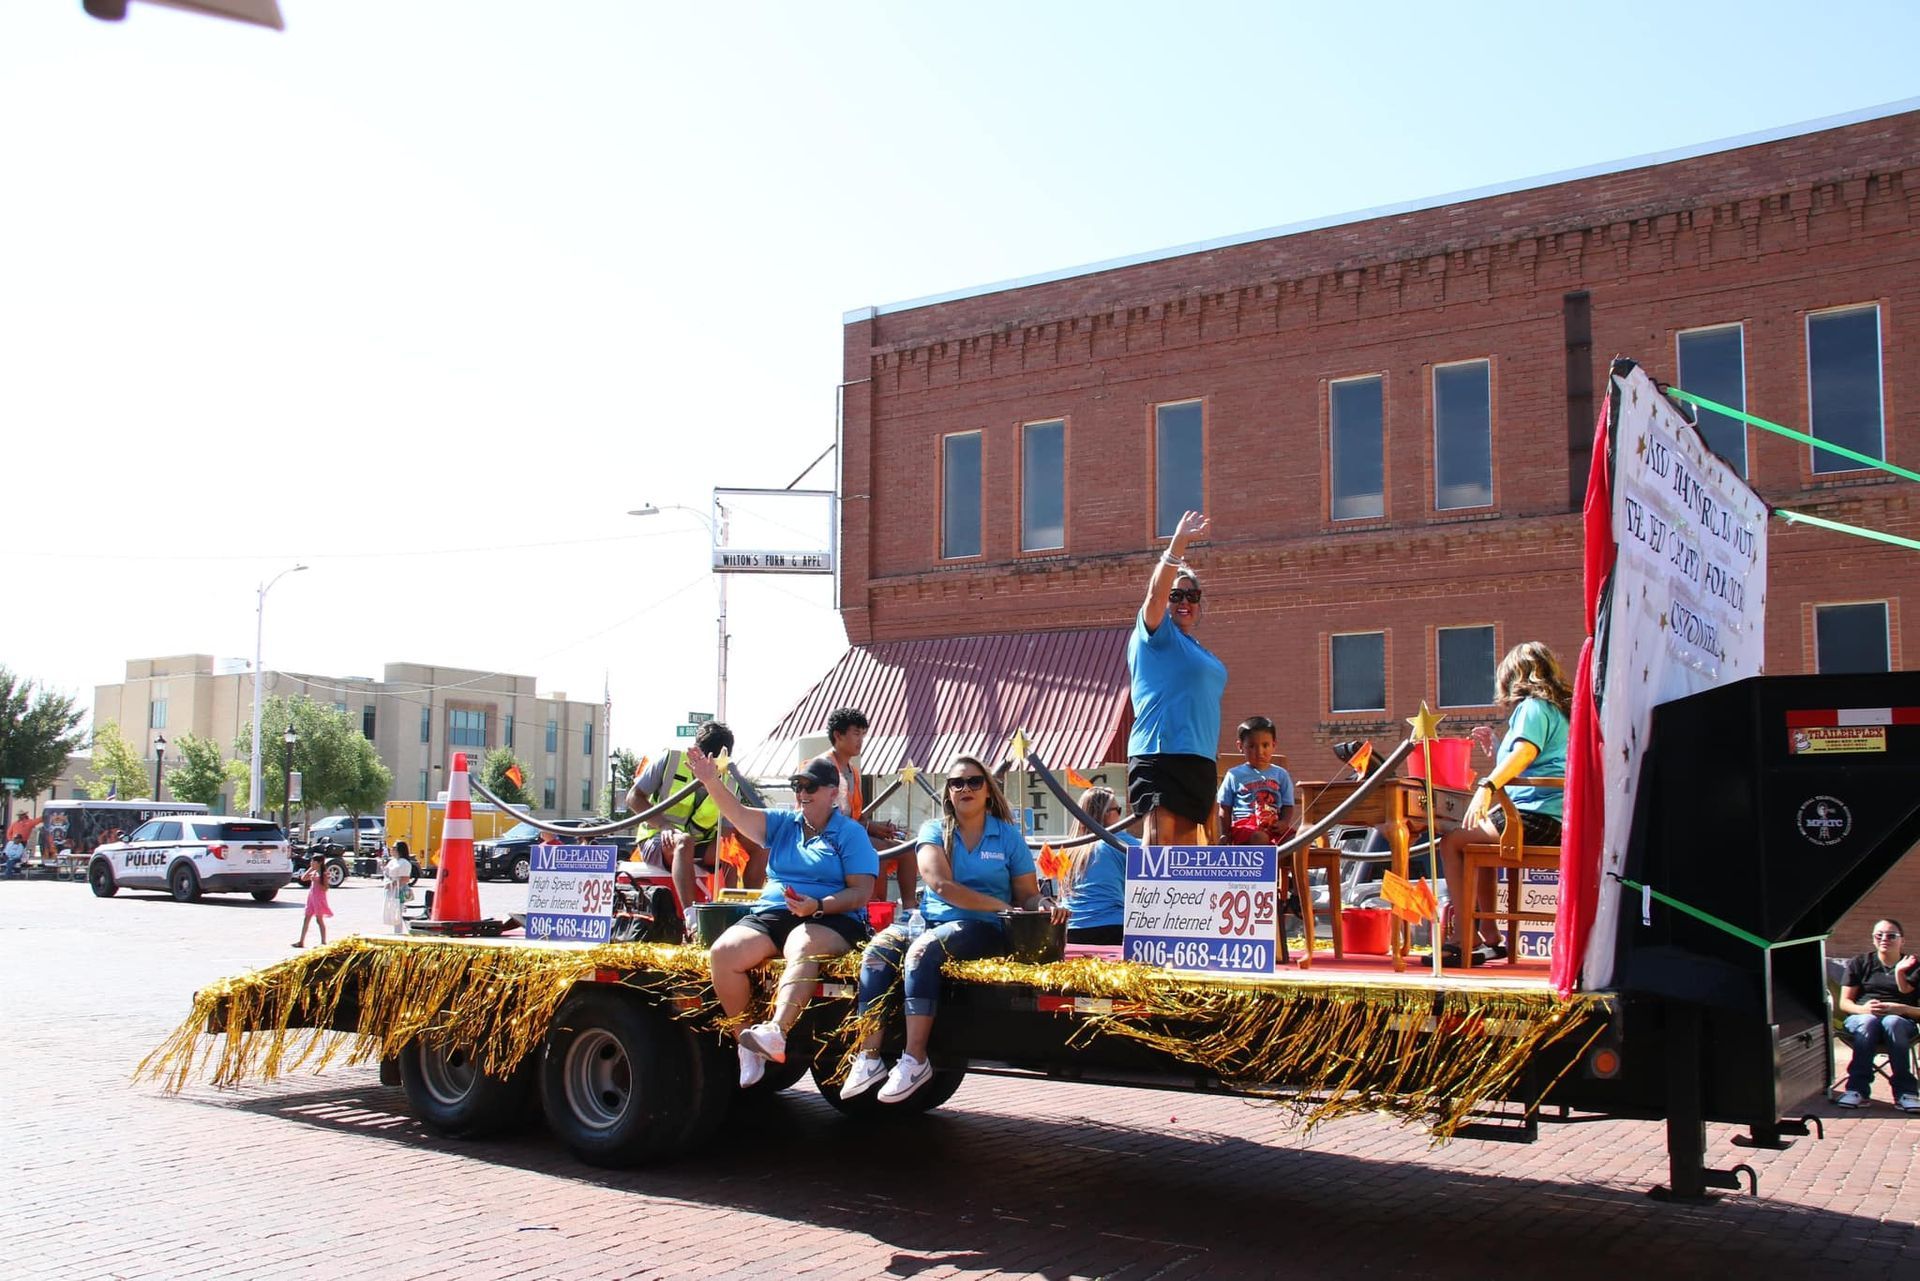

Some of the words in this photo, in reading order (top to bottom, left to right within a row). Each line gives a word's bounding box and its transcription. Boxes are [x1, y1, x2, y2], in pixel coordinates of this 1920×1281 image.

[723, 554, 759, 567] WILTON'S
[765, 555, 785, 566] FURN
[802, 555, 822, 567] APPL
[125, 850, 168, 867] POLICE
[1172, 868, 1262, 878] COMMUNICATIONS
[532, 876, 550, 893] High
[551, 876, 576, 893] Speed
[528, 895, 549, 908] Fiber
[550, 896, 579, 909] Internet
[1131, 887, 1160, 908] High
[1163, 887, 1206, 909] Speed
[531, 916, 606, 939] 806-668-4420
[1126, 911, 1160, 930] Fiber
[1163, 913, 1213, 931] Internet
[1132, 940, 1267, 970] 806-668-4420
